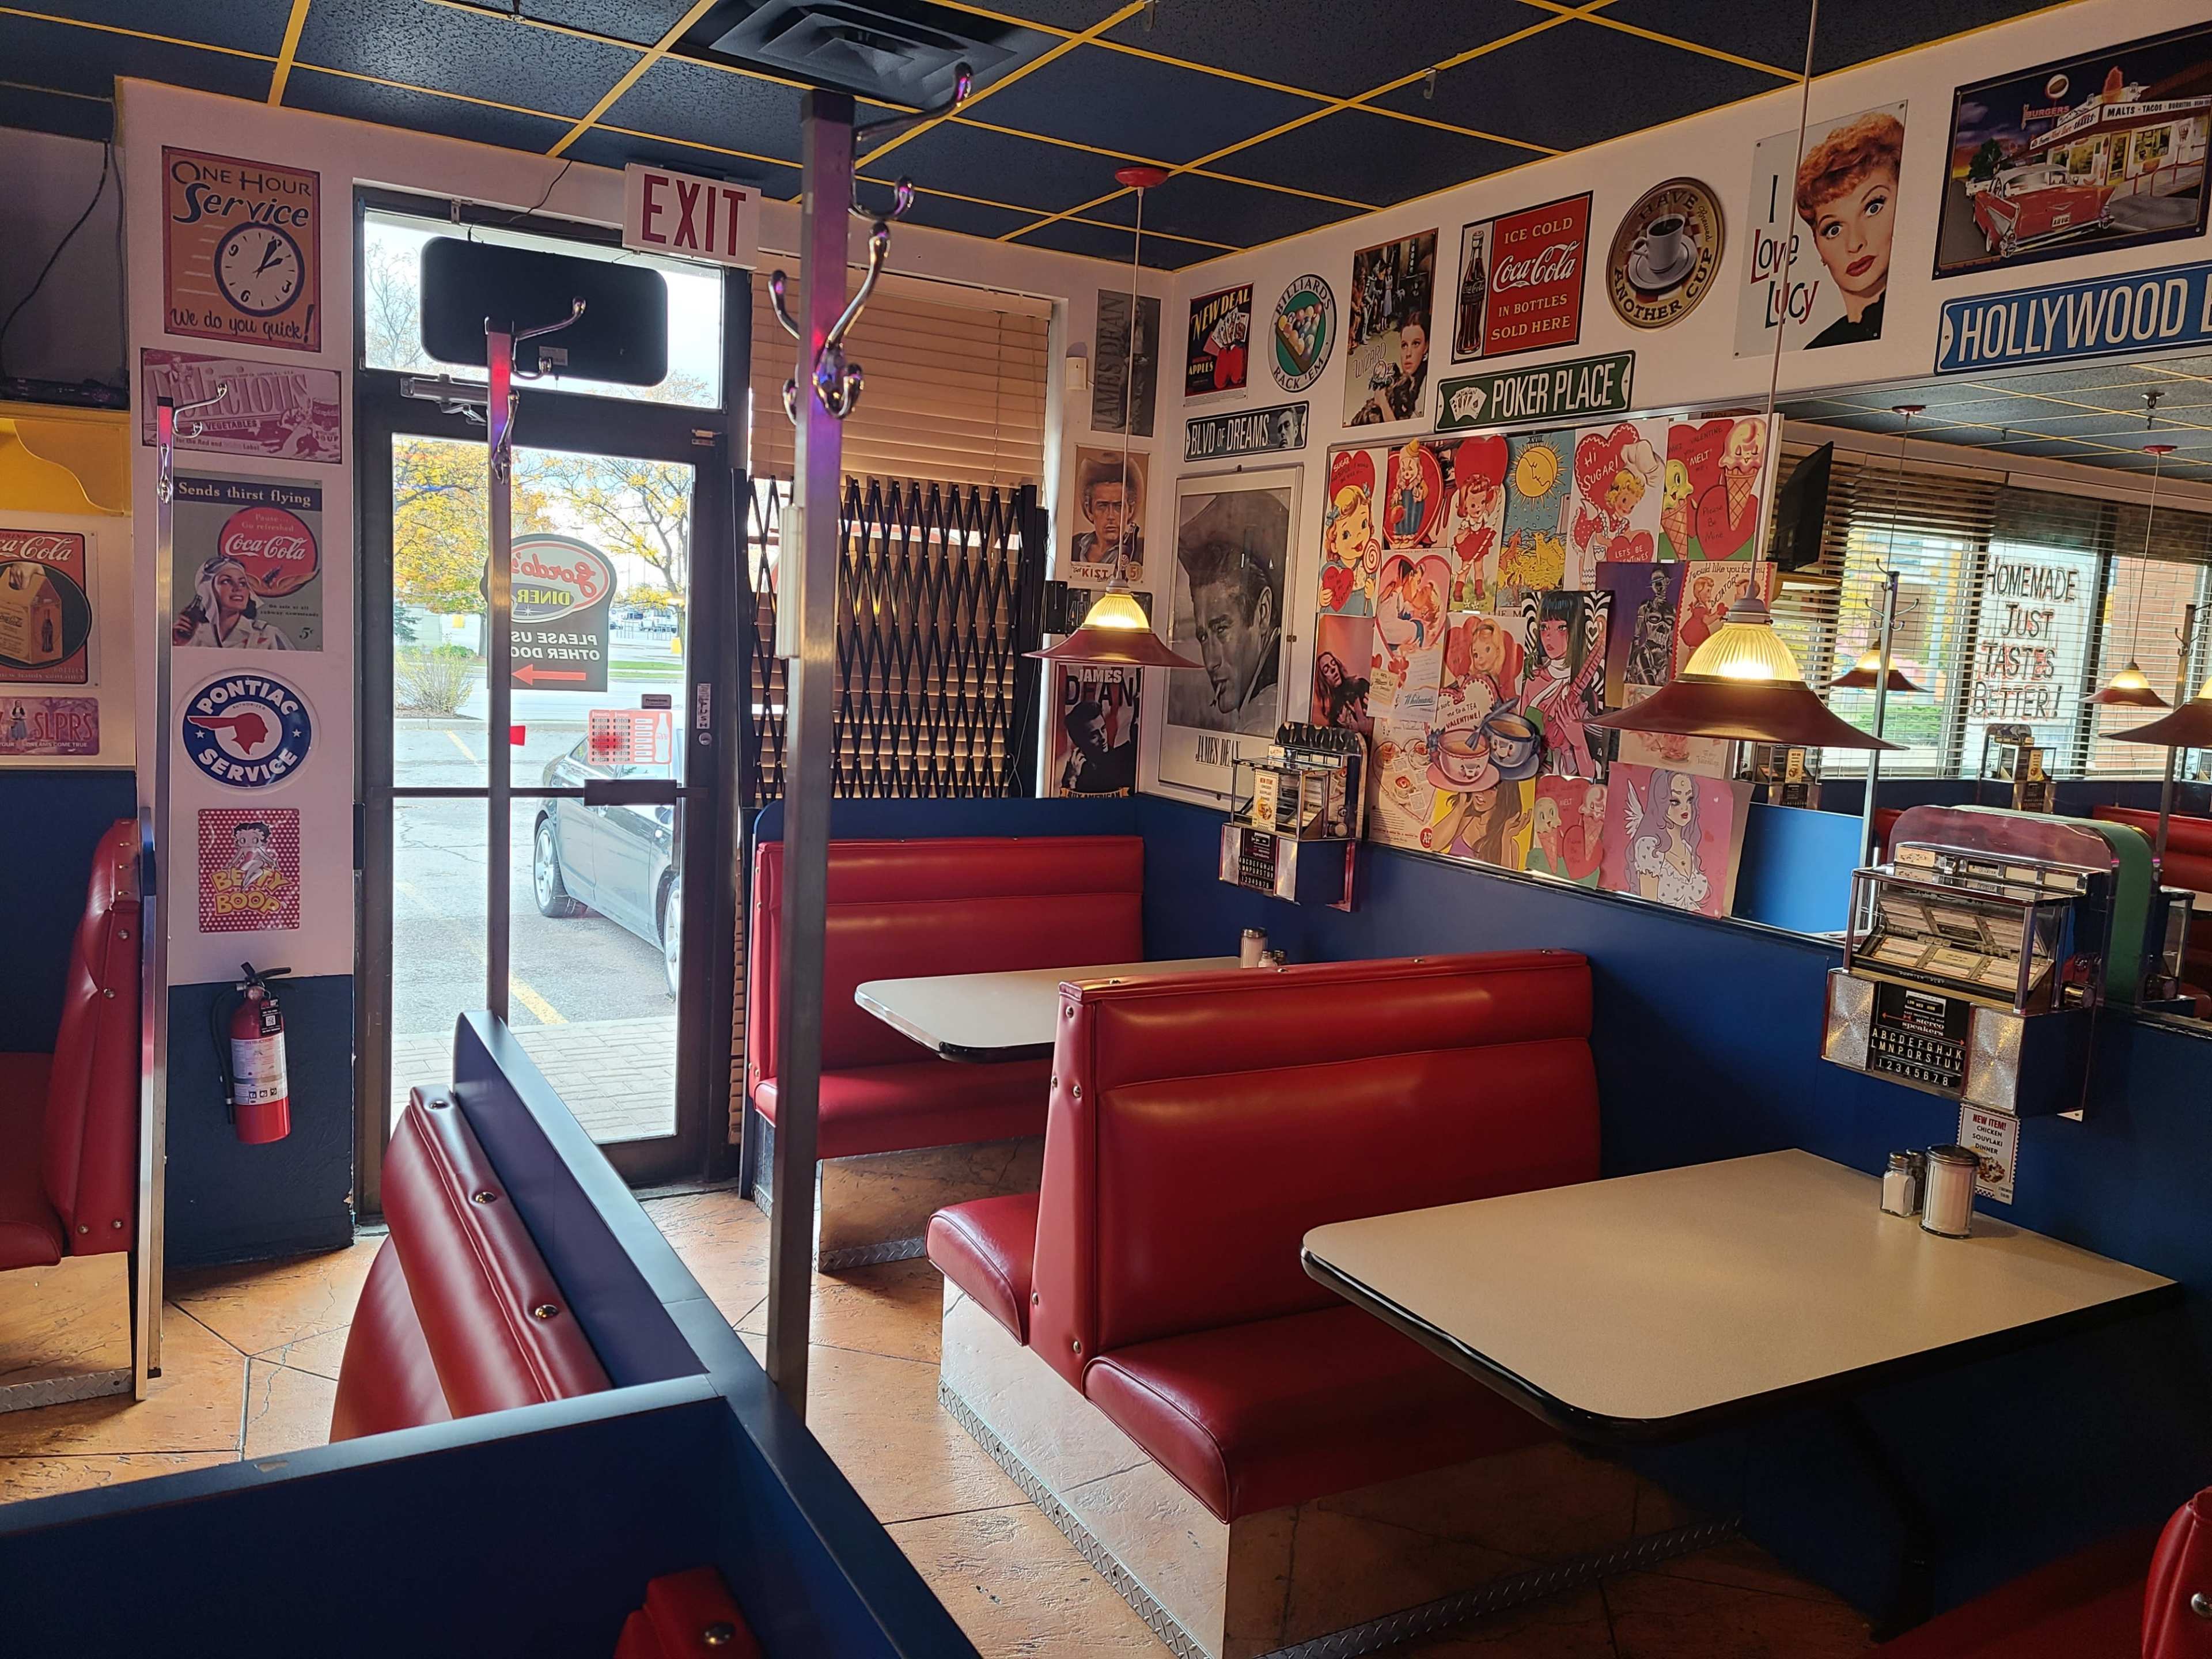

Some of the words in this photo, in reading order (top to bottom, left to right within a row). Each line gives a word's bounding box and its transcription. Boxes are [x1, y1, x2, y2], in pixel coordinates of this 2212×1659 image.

[2026, 105, 2070, 118] BURGERS
[2107, 106, 2135, 118] MALTS
[2142, 104, 2162, 113] TACOS
[239, 171, 312, 196] HOUR
[172, 182, 309, 226] Service
[1638, 191, 1699, 219] HAVE
[1769, 175, 1778, 223] I
[642, 173, 747, 257] EXIT
[1505, 229, 1528, 244] ICE
[1532, 217, 1573, 237] COLD
[1493, 240, 1581, 293] Coca-Cola
[1751, 229, 1800, 285] Love
[1275, 277, 1332, 316] BILLIARDS
[1615, 267, 1683, 320] ANOTHER
[1686, 247, 1713, 298] CUP
[1192, 298, 1221, 341] NEW
[1221, 288, 1249, 312] DEAL
[1498, 305, 1510, 317] IN
[1514, 294, 1568, 313] BOTTLES
[1764, 280, 1820, 329] Lucy
[171, 308, 198, 327] We
[204, 310, 223, 329] do
[230, 318, 257, 335] you
[263, 304, 315, 343] quick!
[1100, 296, 1126, 358] DEAN
[1491, 321, 1528, 341] SOLD
[1532, 315, 1571, 334] HERE
[1959, 278, 2188, 362] HOLLYWOOD
[1188, 361, 1214, 375] APPLES
[1354, 342, 1387, 378] WIZARD
[1274, 368, 1300, 389] RACK
[1491, 373, 1550, 419] POKER
[1553, 362, 1616, 412] PLACE
[1096, 359, 1122, 426] JAMES
[206, 419, 258, 430] VEGETABLES
[1191, 422, 1216, 456] BLVD
[1217, 427, 1226, 447] OF
[1226, 414, 1270, 451] DREAMS
[1691, 425, 1724, 443] VALENTINE
[1584, 447, 1597, 468] Hi
[1584, 455, 1619, 491] SUGAR!
[178, 482, 220, 498] Sends
[227, 486, 264, 501] thirst
[271, 489, 312, 507] flying
[257, 522, 294, 532] refreshed
[225, 533, 308, 560] Coca-Cola
[1615, 548, 1631, 558] LET'S
[1635, 545, 1643, 553] BE
[1082, 567, 1109, 578] KIST
[1711, 562, 1725, 573] like
[1726, 566, 1741, 579] you
[1741, 562, 1751, 573] for
[1987, 555, 2079, 603] HOMEMADE
[2001, 602, 2055, 640] JUST
[1982, 641, 2056, 681] TASTES
[1077, 668, 1122, 683] JAMES
[196, 680, 298, 715] PONTIAC
[1066, 675, 1134, 707] DEAN
[1404, 692, 1434, 705] Whitman's
[1972, 681, 2064, 719] BETTER!
[1446, 710, 1481, 729] VALENTINE!
[1466, 702, 1478, 710] TEA
[34, 712, 93, 741] SLPRS
[1195, 734, 1219, 766] JAMES
[1220, 738, 1241, 768] DEAN
[198, 748, 298, 782] SERVICE
[211, 867, 293, 892] BETY
[215, 891, 281, 915] BOOP
[1902, 1021, 1944, 1036] speakers
[1916, 1017, 1945, 1030] stereo
[1972, 1113, 1987, 1124] NEW
[1988, 1118, 2006, 1131] ITEM!
[1976, 1125, 2002, 1138] CHICKEN
[1972, 1133, 2003, 1147] SOUVLAKI
[1975, 1143, 1998, 1155] DINNER
